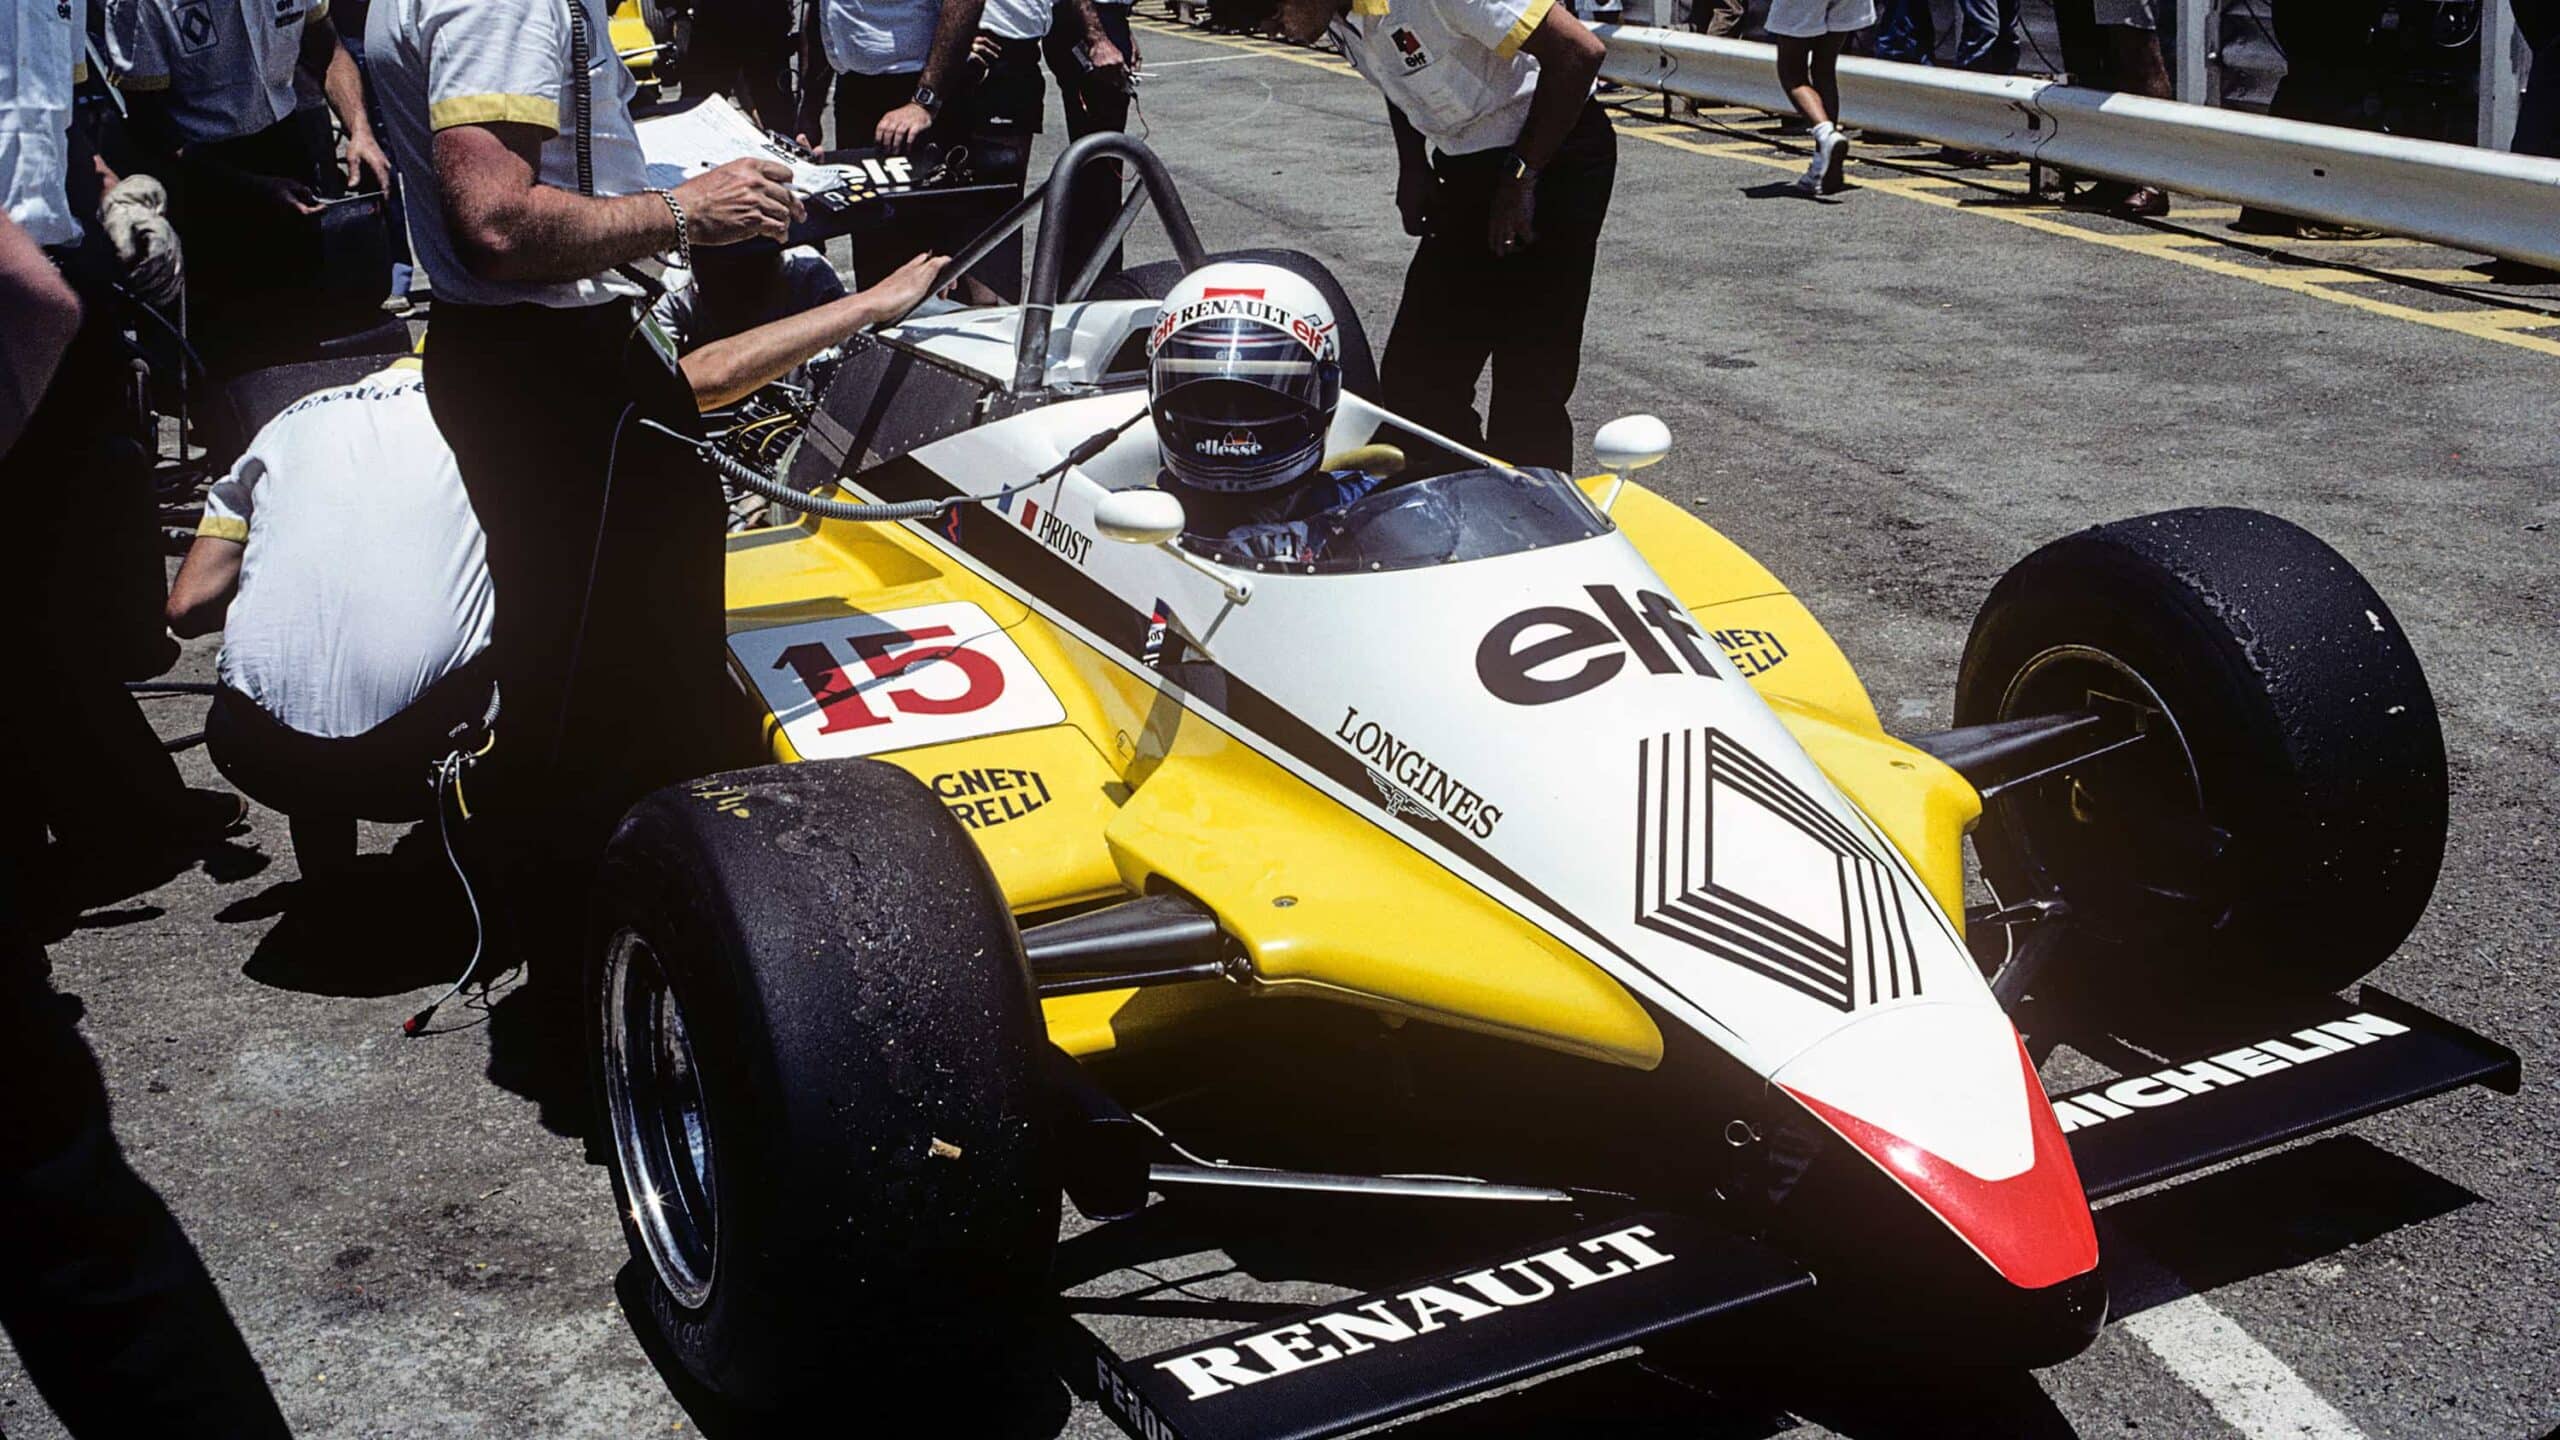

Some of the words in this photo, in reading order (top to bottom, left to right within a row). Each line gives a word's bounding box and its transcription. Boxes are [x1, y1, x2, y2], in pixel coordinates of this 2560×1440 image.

[1405, 52, 1426, 67] elf
[1153, 312, 1177, 349] elf
[1181, 300, 1290, 325] RENAULT
[1292, 319, 1325, 353] elf
[1195, 439, 1263, 456] ellesse
[1038, 510, 1092, 566] PROST
[1475, 584, 1724, 706] elf
[772, 624, 1005, 736] 15
[1335, 705, 1503, 839] LONGINES
[1153, 1224, 1675, 1401] RENAULT
